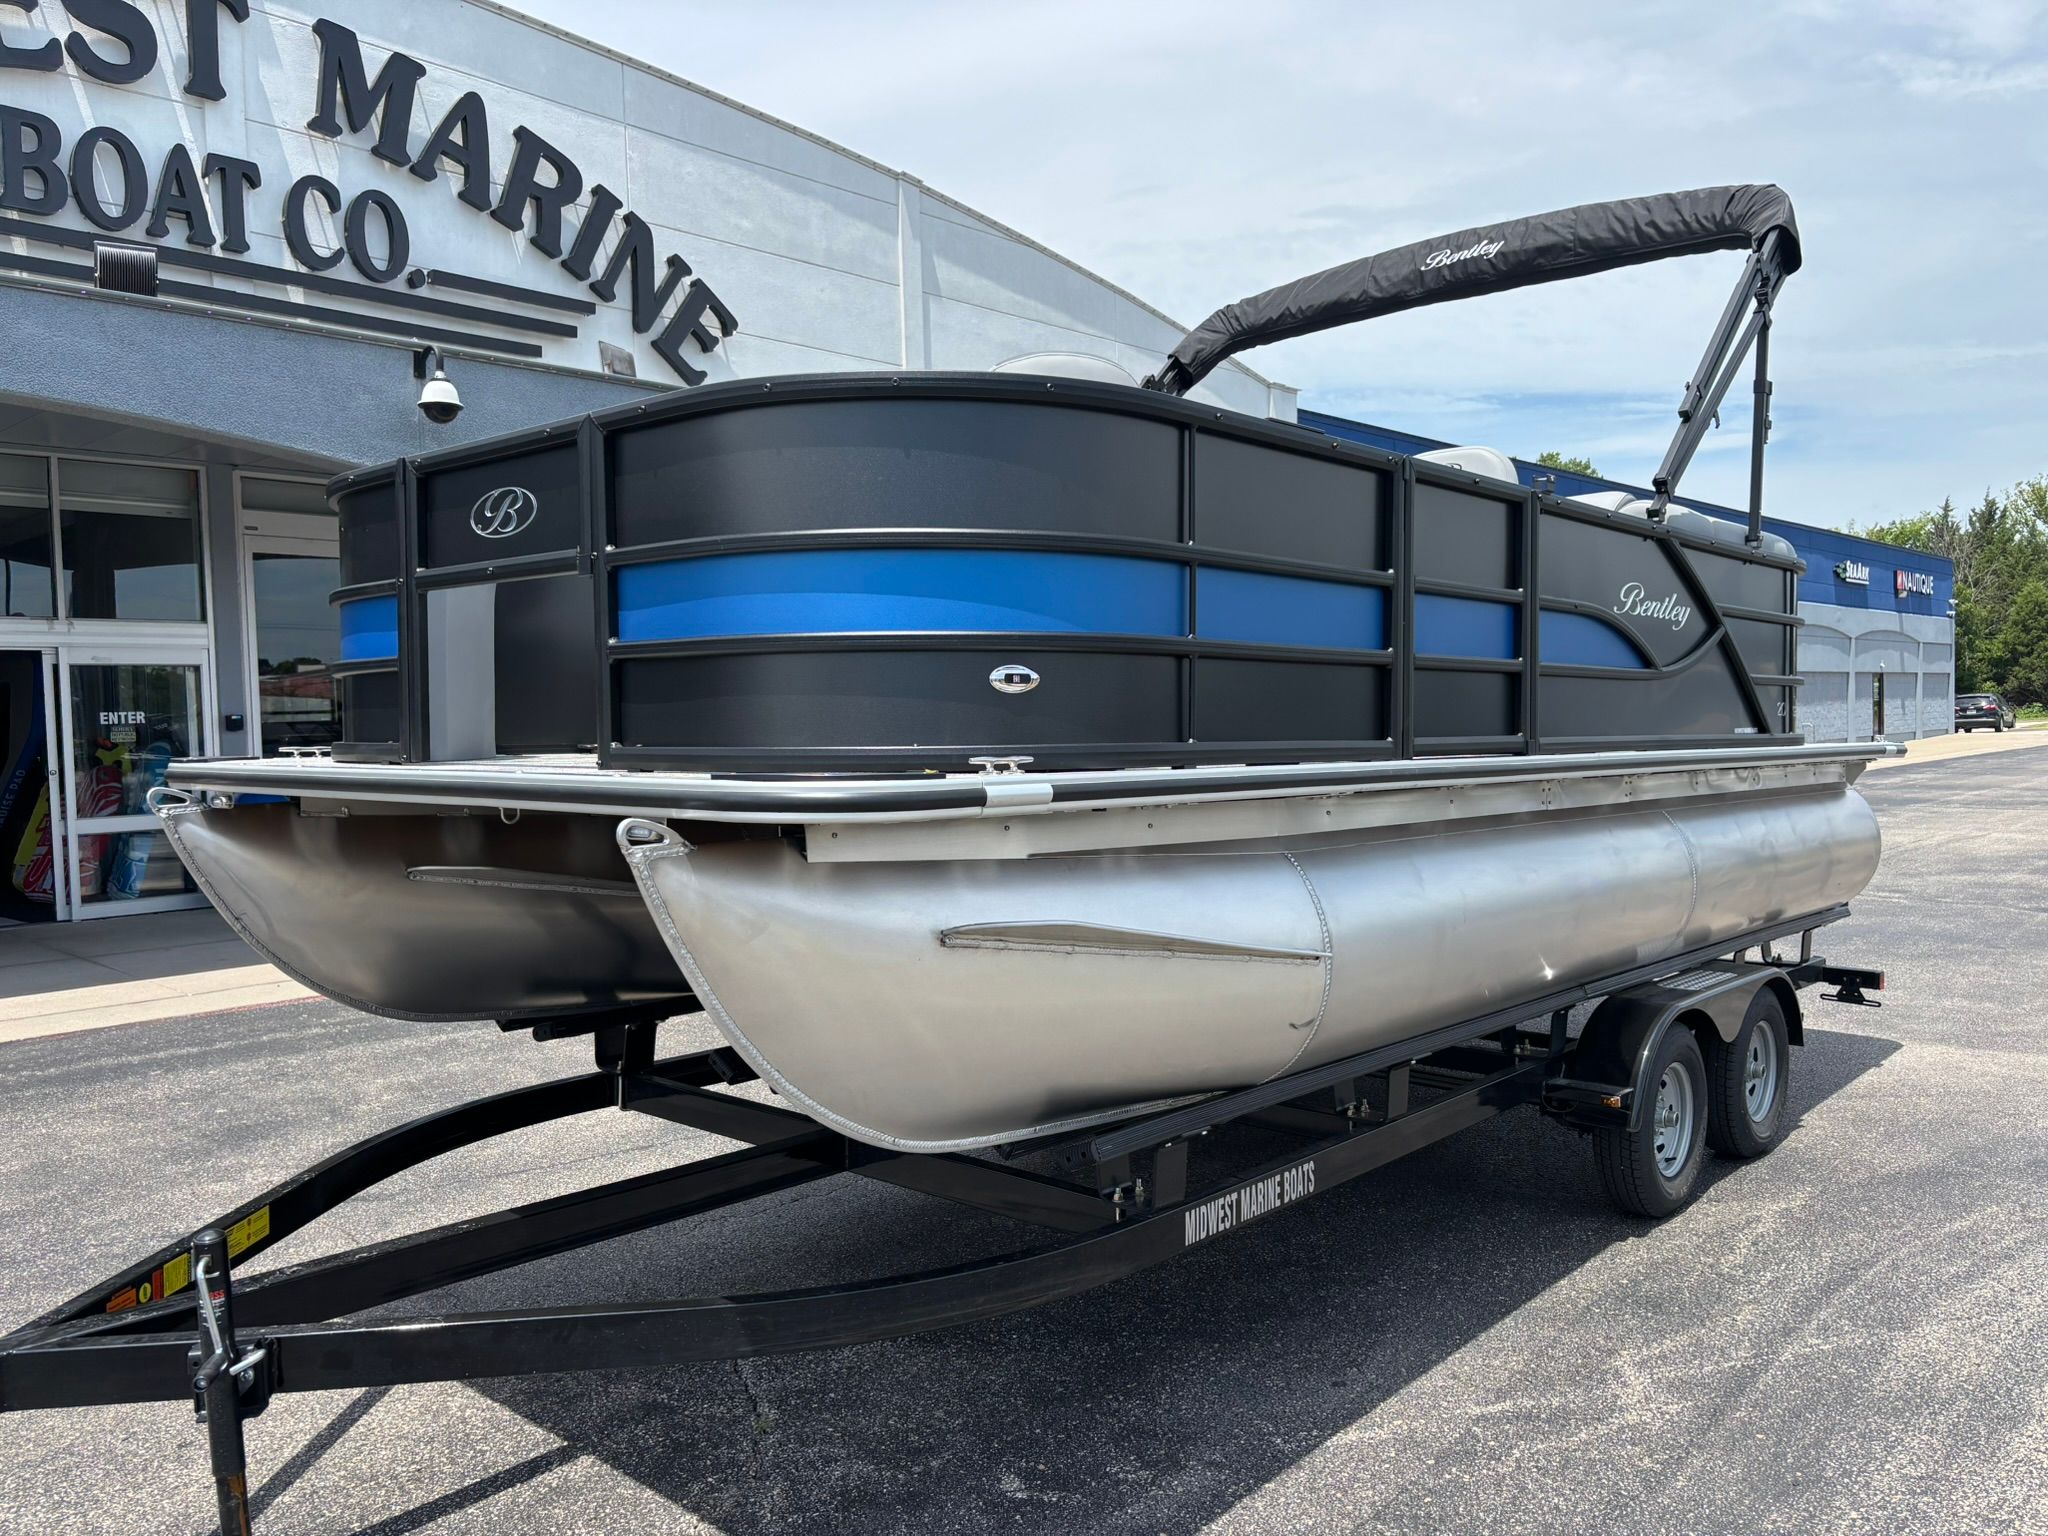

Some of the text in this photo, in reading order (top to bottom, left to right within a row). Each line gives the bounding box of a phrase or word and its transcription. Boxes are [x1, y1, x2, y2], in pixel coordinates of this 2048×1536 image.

[0, 104, 427, 289] BOAT CO.
[306, 17, 739, 386] MARINE
[1420, 239, 1505, 271] Bentley
[1613, 582, 1691, 631] Bentley
[1902, 570, 1934, 595] NAUTIQUE
[99, 711, 146, 725] ENTER
[1184, 1160, 1315, 1247] MIDWEST MARINE BOATS
